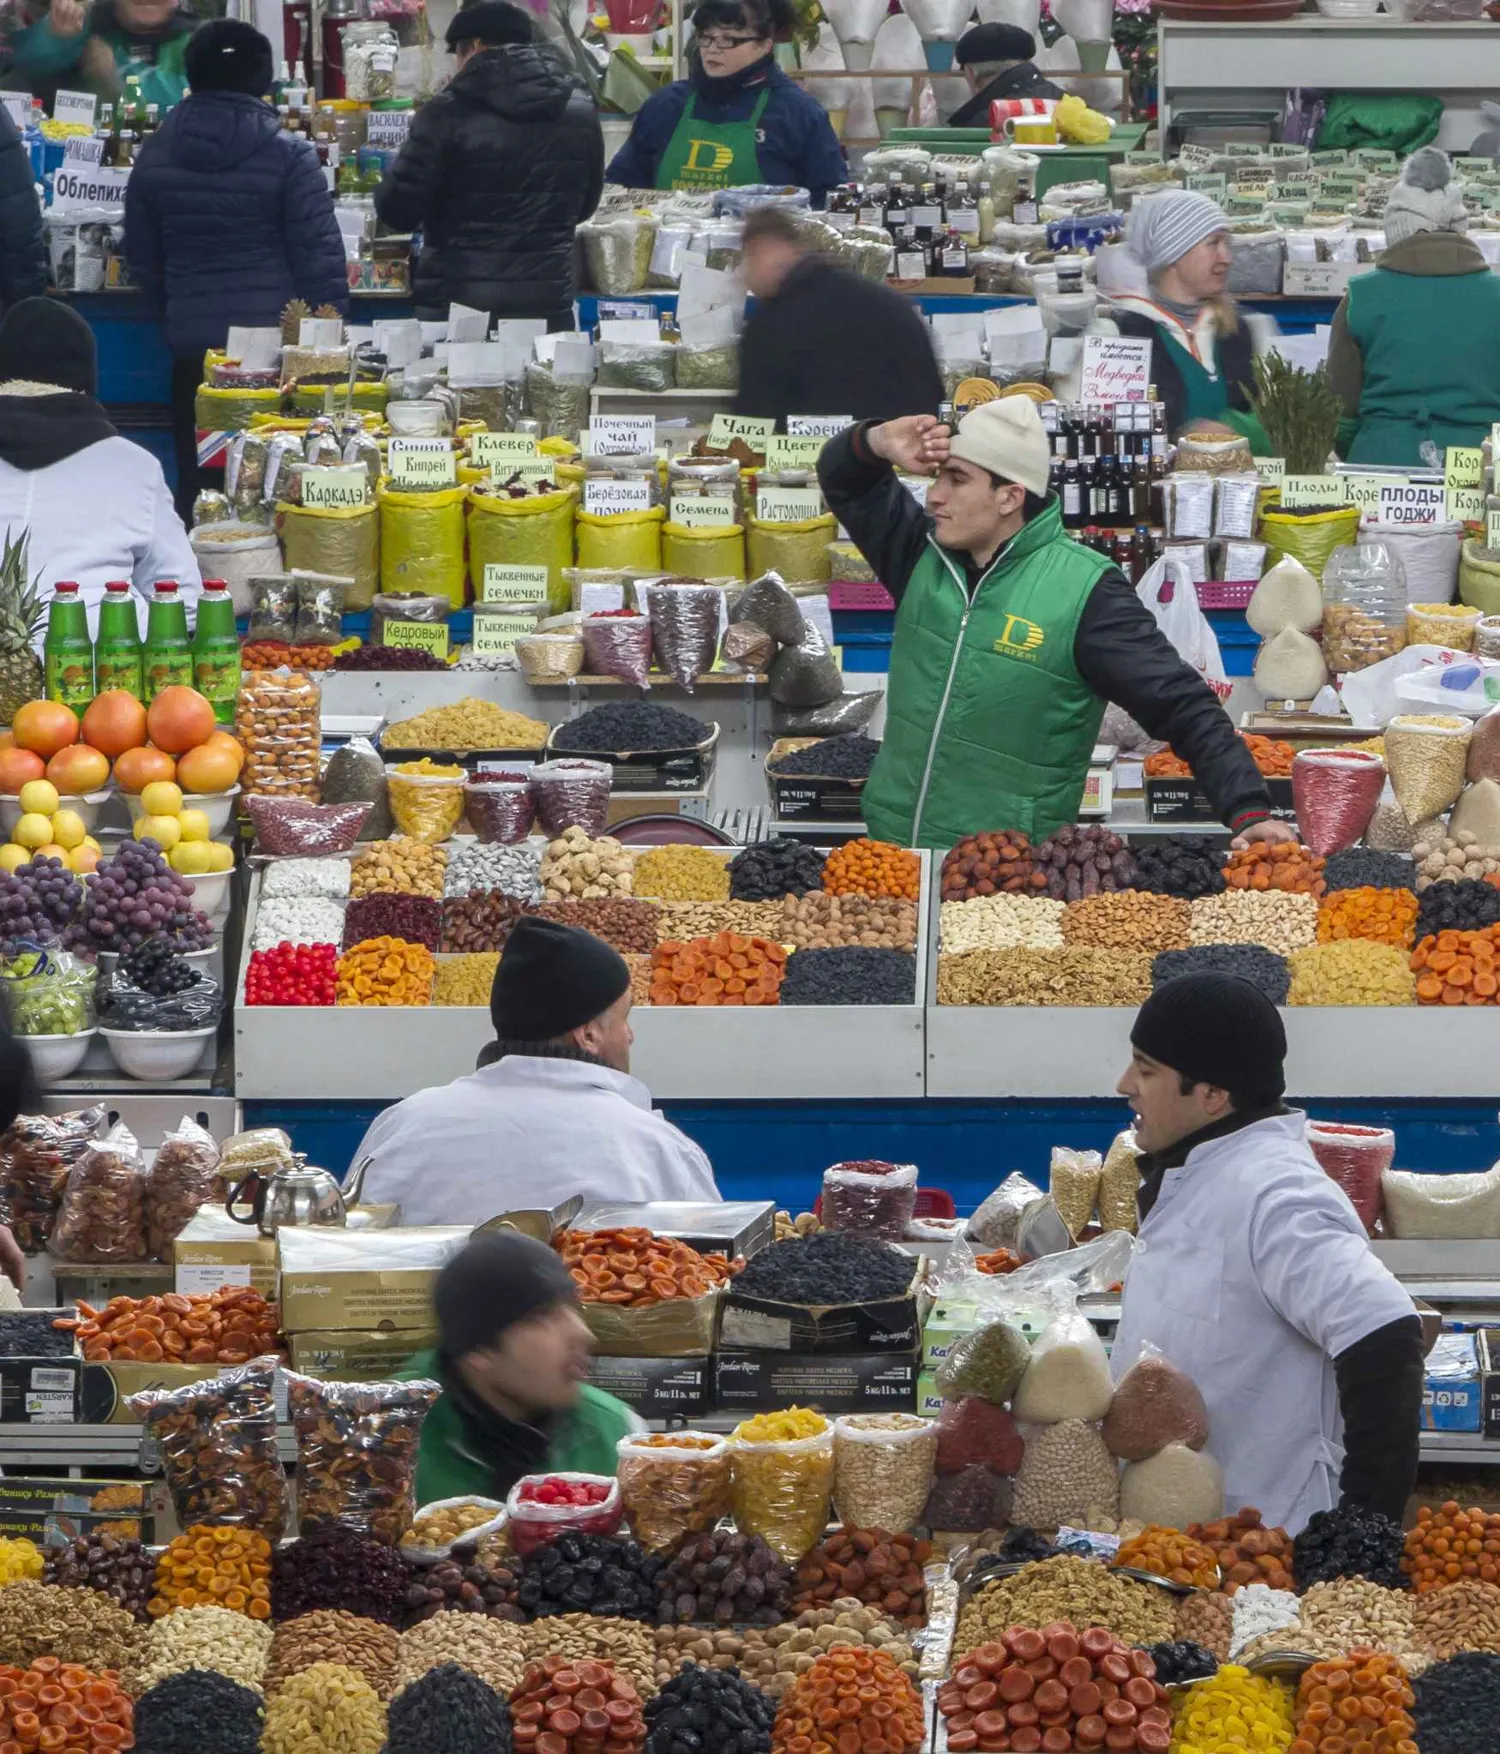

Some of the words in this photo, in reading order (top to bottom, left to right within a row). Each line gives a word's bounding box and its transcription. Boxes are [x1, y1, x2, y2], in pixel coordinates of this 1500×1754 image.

[594, 417, 652, 431] Почечный
[722, 417, 765, 437] Чага
[478, 436, 535, 454] Клевер
[608, 431, 637, 443] чай
[777, 438, 819, 454] Цвет
[306, 482, 363, 506] Каркадэ
[1288, 481, 1338, 494] Плоды
[1345, 484, 1379, 507] Коре
[1381, 488, 1444, 505] ПЛОДЫ
[675, 502, 730, 516] Семена
[1386, 506, 1436, 521] ГОДЖИ
[487, 567, 545, 583] Тыквенные
[488, 588, 544, 599] семечки
[387, 623, 445, 641] Кедровый
[36, 1393, 73, 1401] KARSTEN
